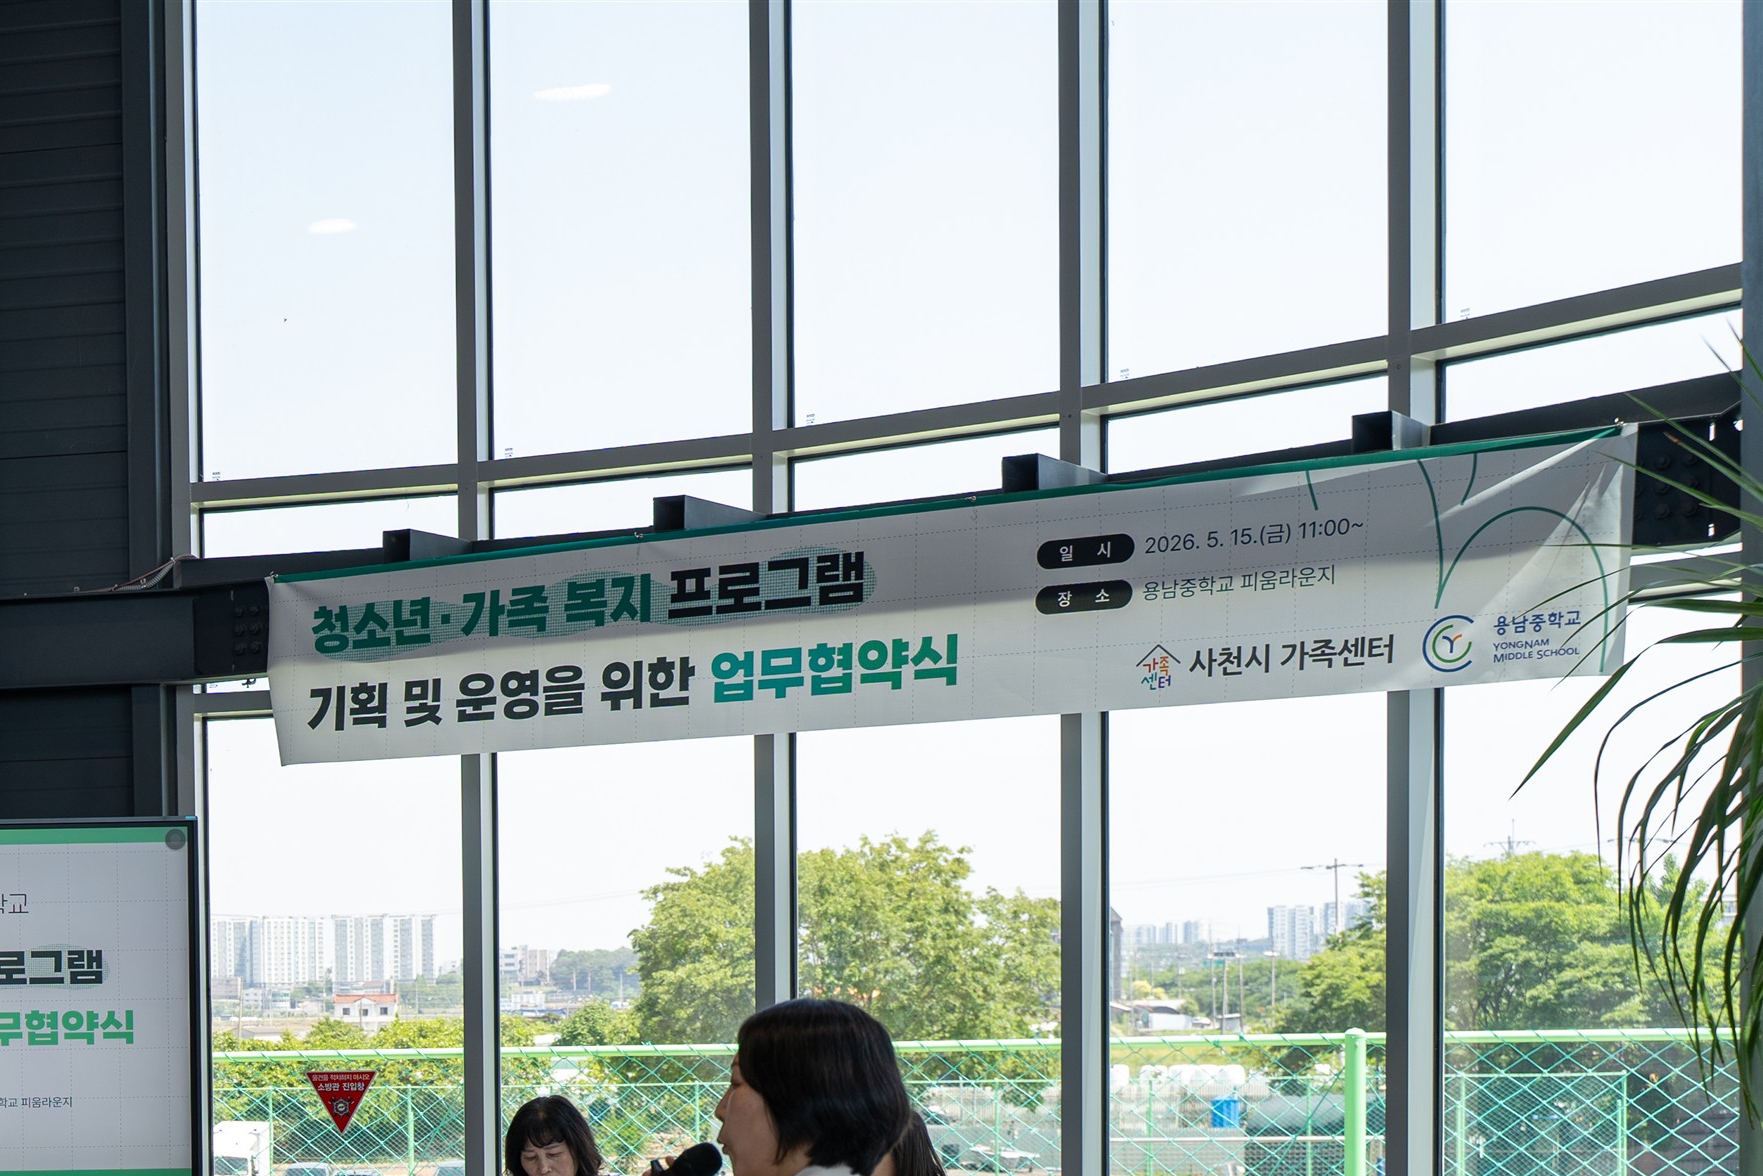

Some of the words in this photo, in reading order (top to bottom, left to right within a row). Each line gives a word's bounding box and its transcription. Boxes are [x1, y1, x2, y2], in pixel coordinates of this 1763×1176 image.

[1144, 536, 1200, 555] 2026.
[1206, 532, 1224, 549] 5.
[1234, 523, 1292, 547] 15.(금)
[1298, 517, 1364, 540] 11:00~
[1059, 546, 1073, 562] 일
[1097, 541, 1112, 558] 시
[563, 573, 651, 627] 복지
[667, 551, 865, 620] 프로그램
[1142, 574, 1235, 602] 용남중학교
[1240, 564, 1337, 593] 피움라운지
[1057, 591, 1072, 607] 장
[1094, 588, 1111, 604] 소
[1493, 610, 1582, 636] 용남중학교
[1493, 638, 1550, 652] YONGNAM
[1493, 650, 1534, 664] MIDDLE
[1536, 646, 1581, 660] SCHOOL
[1142, 655, 1170, 676] 가족
[1188, 642, 1271, 678] 사천시
[1279, 634, 1395, 671] 가족센터
[306, 681, 389, 732] 기획
[403, 677, 443, 728] 및
[455, 664, 586, 723] 운영을
[600, 656, 696, 711] 위한
[710, 633, 958, 704] 업무협약식
[1140, 672, 1172, 691] 센터
[21, 1096, 73, 1108] 피움라운지
